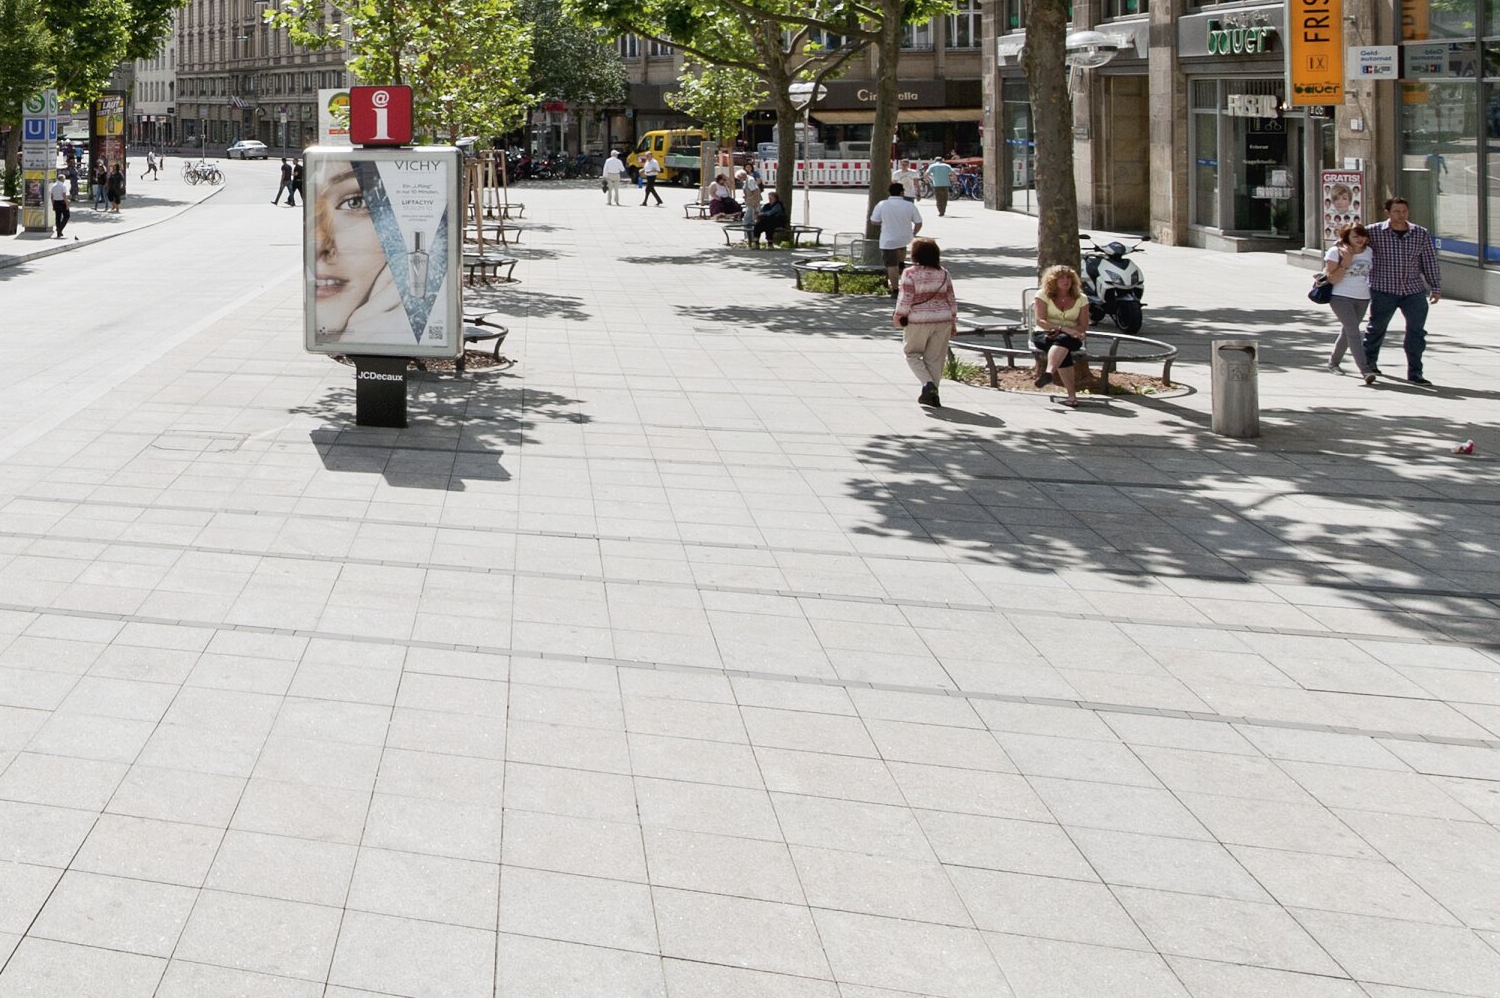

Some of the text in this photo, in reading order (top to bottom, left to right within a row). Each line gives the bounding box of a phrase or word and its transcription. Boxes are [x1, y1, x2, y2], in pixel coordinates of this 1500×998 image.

[1207, 18, 1276, 55] bauer
[1293, 83, 1340, 94] bauer
[1228, 94, 1278, 118] FRISEUR
[29, 120, 42, 135] U
[394, 160, 442, 171] VICHY
[1323, 173, 1361, 183] GRATIS!
[358, 371, 403, 382] JCDecaux
